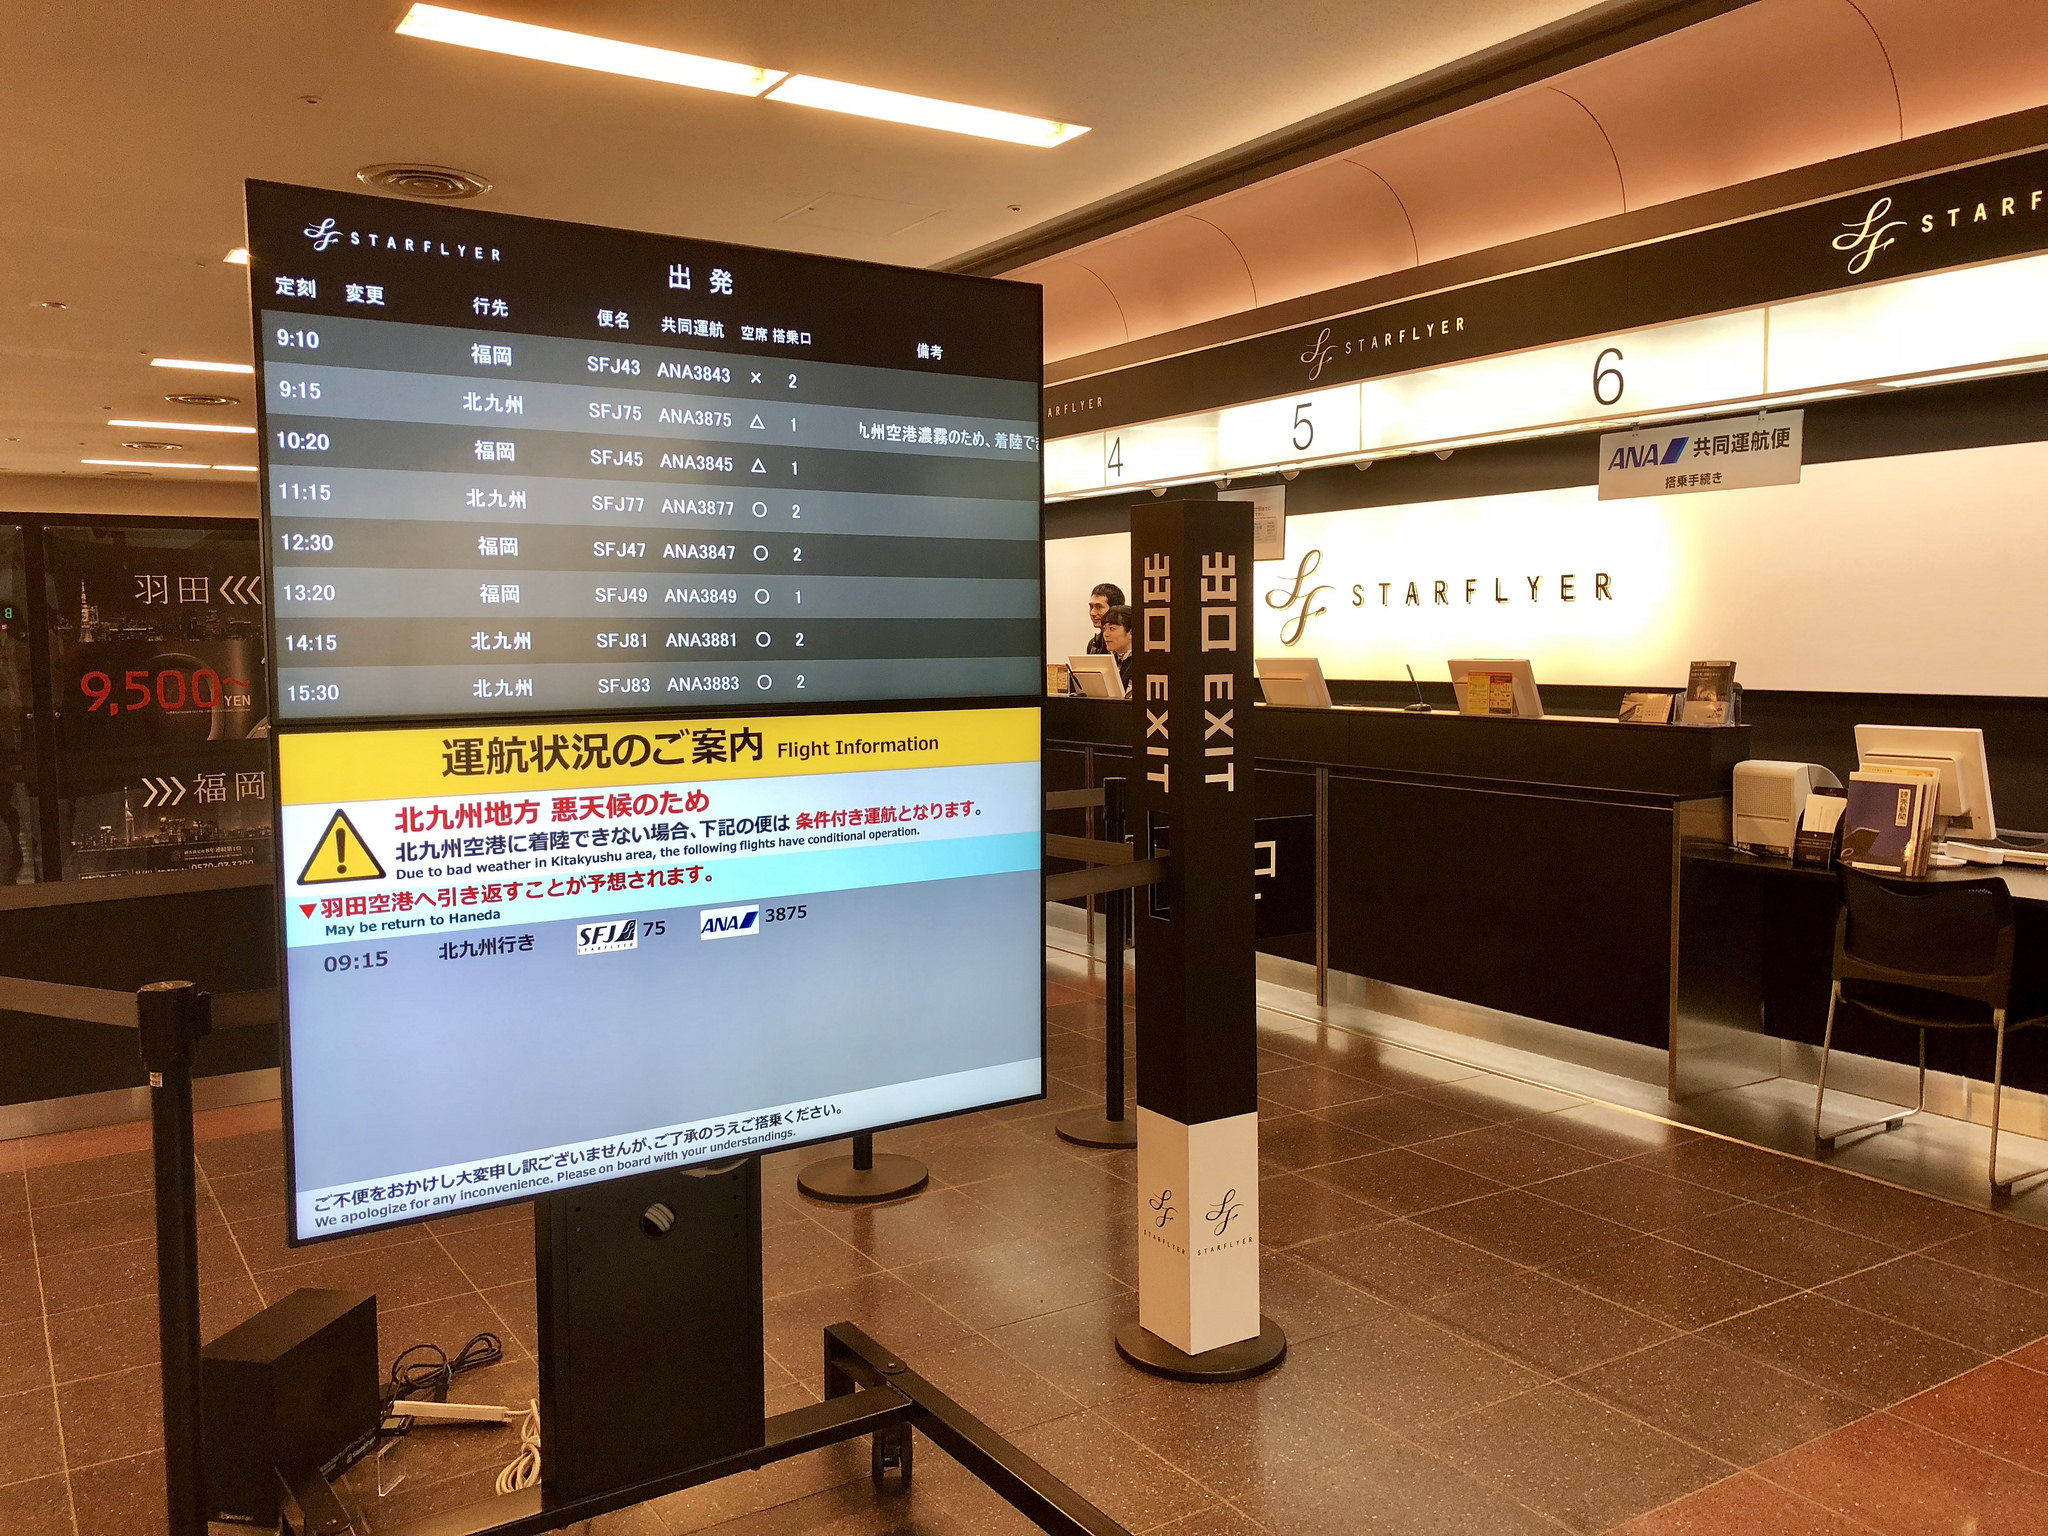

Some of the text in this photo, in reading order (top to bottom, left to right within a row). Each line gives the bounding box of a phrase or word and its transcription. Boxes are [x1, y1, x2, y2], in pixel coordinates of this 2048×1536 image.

[351, 231, 501, 262] STARFLYER
[275, 275, 943, 361] 定刻 変更 行先 便名 共同運航 空席 搭乗口 備考
[1345, 316, 1465, 355] STARFLYER
[276, 328, 797, 389] 9:10 福岡 SFJ43 ANA3843 2
[1592, 347, 1624, 406] 6
[279, 380, 321, 400] 9:15
[463, 392, 523, 415] 北九州
[589, 402, 642, 421] SFJ75
[659, 407, 732, 428] ANA3875
[790, 417, 797, 432] 1
[1292, 402, 1314, 451] 5
[277, 431, 798, 475] 10:20 福岡 SFJ45 ANA3845 1
[1107, 436, 1123, 477] 4
[1608, 427, 1791, 471] ANA 共同運航便
[279, 482, 801, 519] 11:15 北九州 SFJ77 ANA3877 2
[1665, 471, 1723, 490] 搭乗手続き
[281, 533, 802, 562] 12:30 福岡 SFJ47 ANA3847 2
[134, 573, 209, 605] 羽田
[283, 583, 802, 604] 13:20 福岡 SFJ49 ANA3849 1
[1352, 571, 1613, 607] STARFLYER
[285, 631, 804, 652] 14:15 北九州 SFJ81 ANA3881 2
[287, 675, 805, 702] 15:30 北九州 SFJ83 ANA3883 2
[1143, 552, 1171, 793] 出口 EXIT
[1201, 551, 1237, 792] 出口 EXIT
[224, 694, 251, 708] YEN
[442, 727, 939, 778] 運航状況のご案内 Flight Information
[193, 770, 266, 804] 福岡
[395, 789, 710, 834] 北九州地方 悪天候のため
[395, 800, 982, 863] 北九州空港に着陸できない場合、下記の便は 条件付き運航となります。
[396, 826, 920, 881] Due to bad weather in Kitakyushu area, the following flights have conditional operation.
[320, 865, 713, 919] 羽田空港へ引き返すことが予想されます。
[323, 905, 808, 974] 09:15 北九州行き SFJ 75 ANA 3875
[325, 909, 501, 938] May be return to Haneda
[314, 1104, 842, 1212] ご不便をおかけし大変申し訳ございませんが、ご了承のうえご搭乗ください。
[315, 1127, 796, 1228] We apologize for any inconvenience. Please on board with your understandings.
[1143, 1229, 1186, 1255] STARFLYER
[1197, 1236, 1253, 1256] STARFLYER
